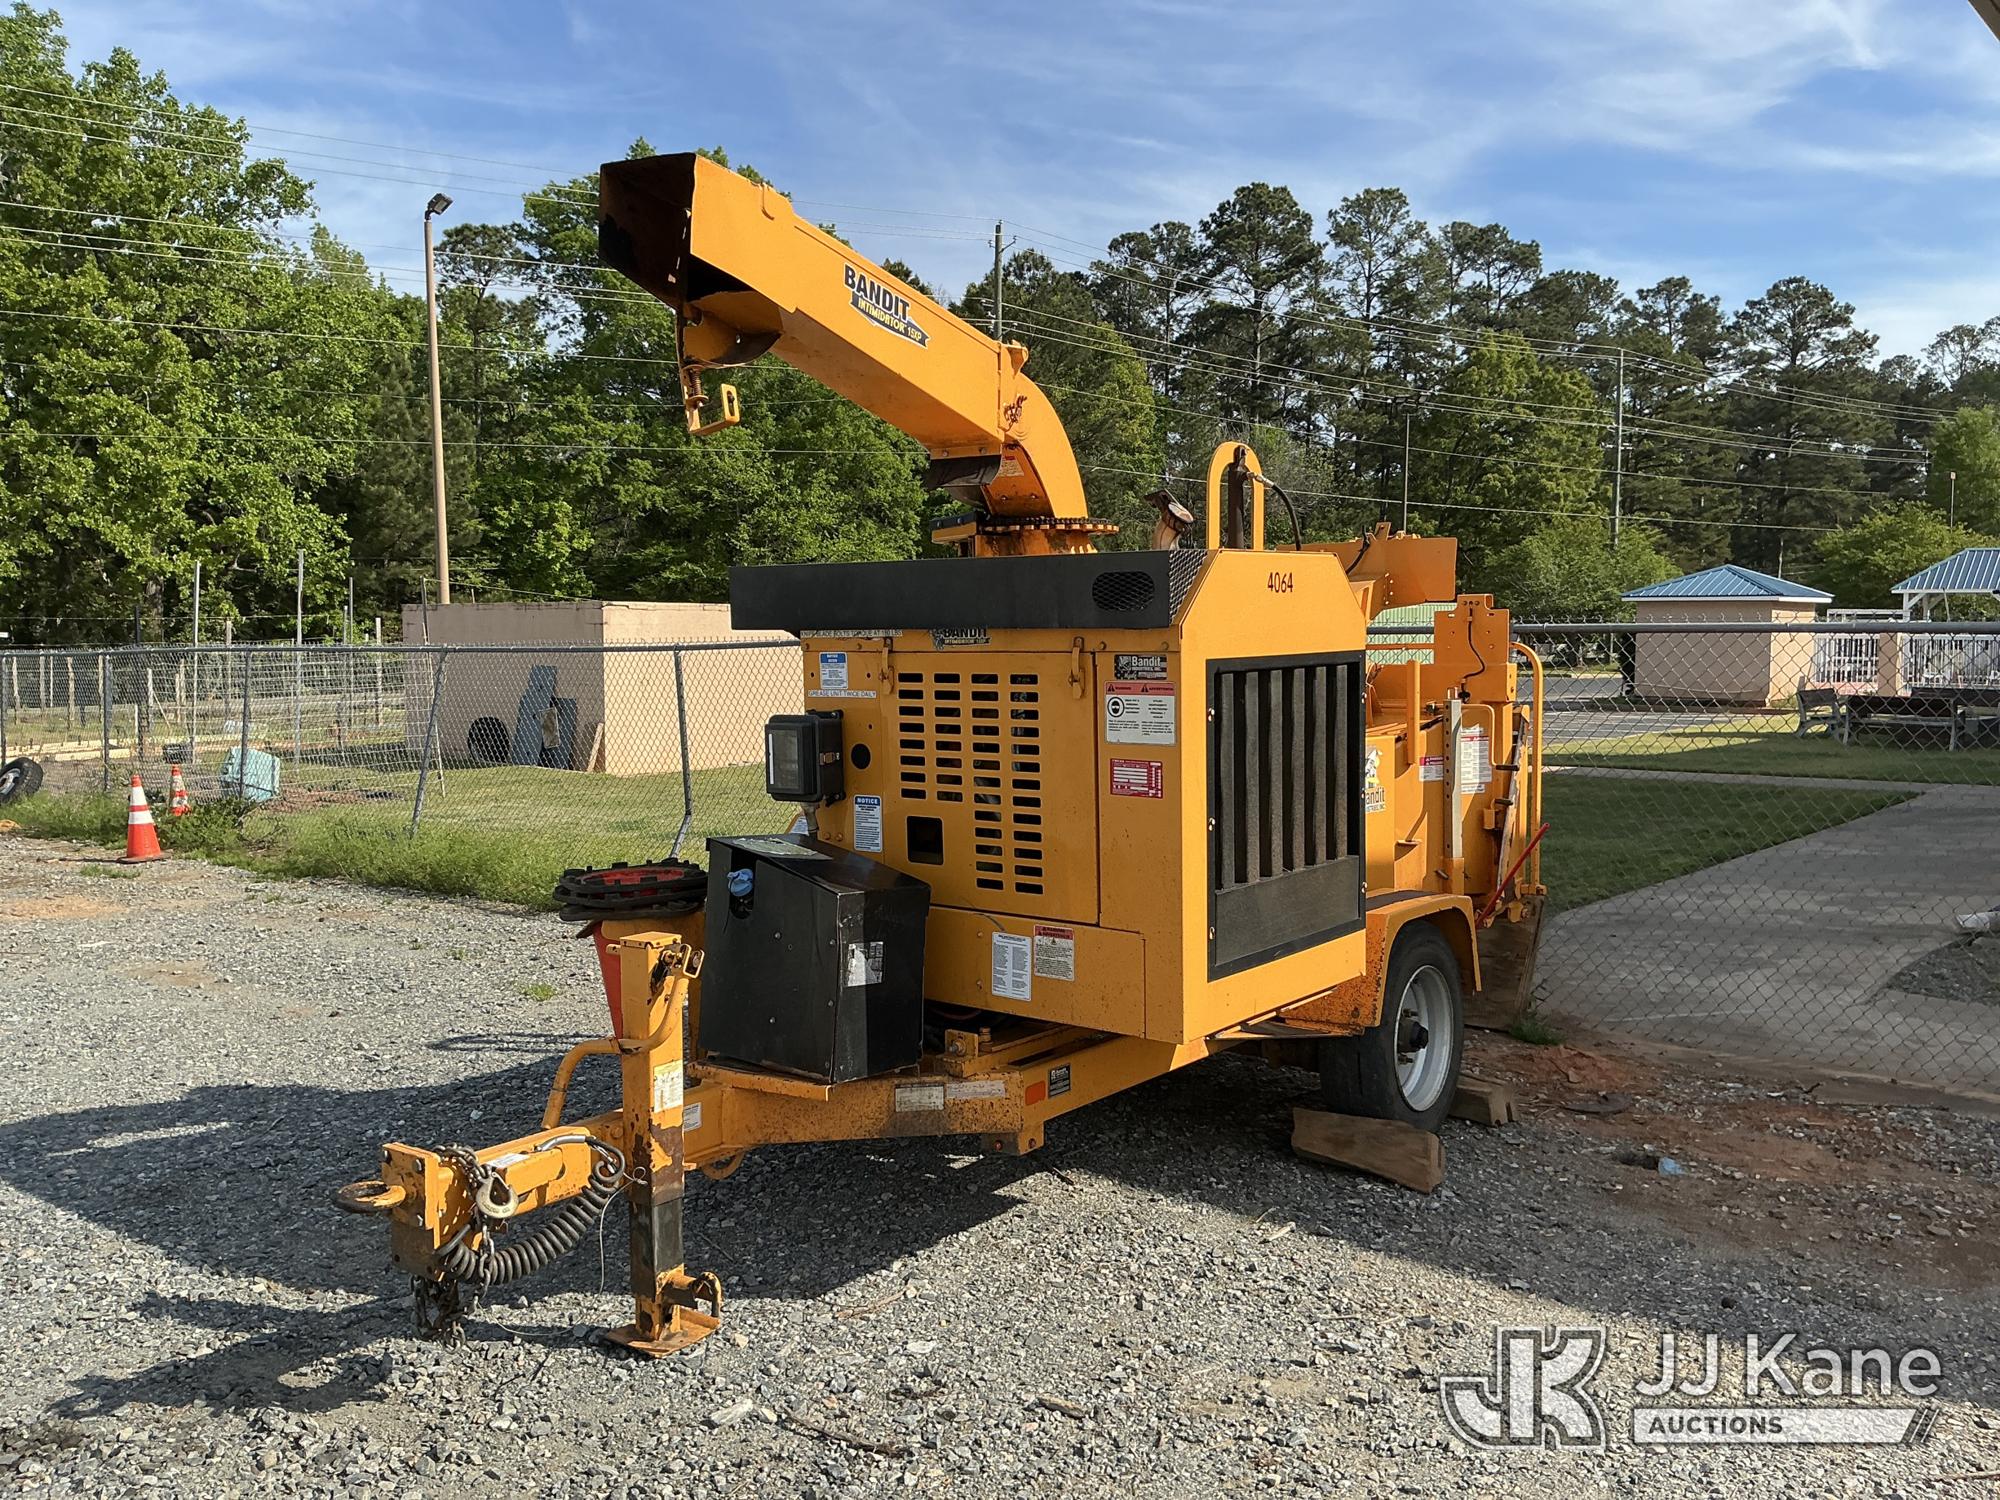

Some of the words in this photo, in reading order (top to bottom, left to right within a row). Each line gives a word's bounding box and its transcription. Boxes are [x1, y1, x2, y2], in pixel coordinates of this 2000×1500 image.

[844, 263, 910, 322] BANDIT
[858, 299, 907, 333] INTIMIDATOR
[907, 326, 922, 341] 15XP
[1267, 571, 1293, 593] 4064
[1131, 655, 1161, 667] Bandit
[857, 797, 878, 805] NOTICE
[1365, 786, 1385, 805] andit
